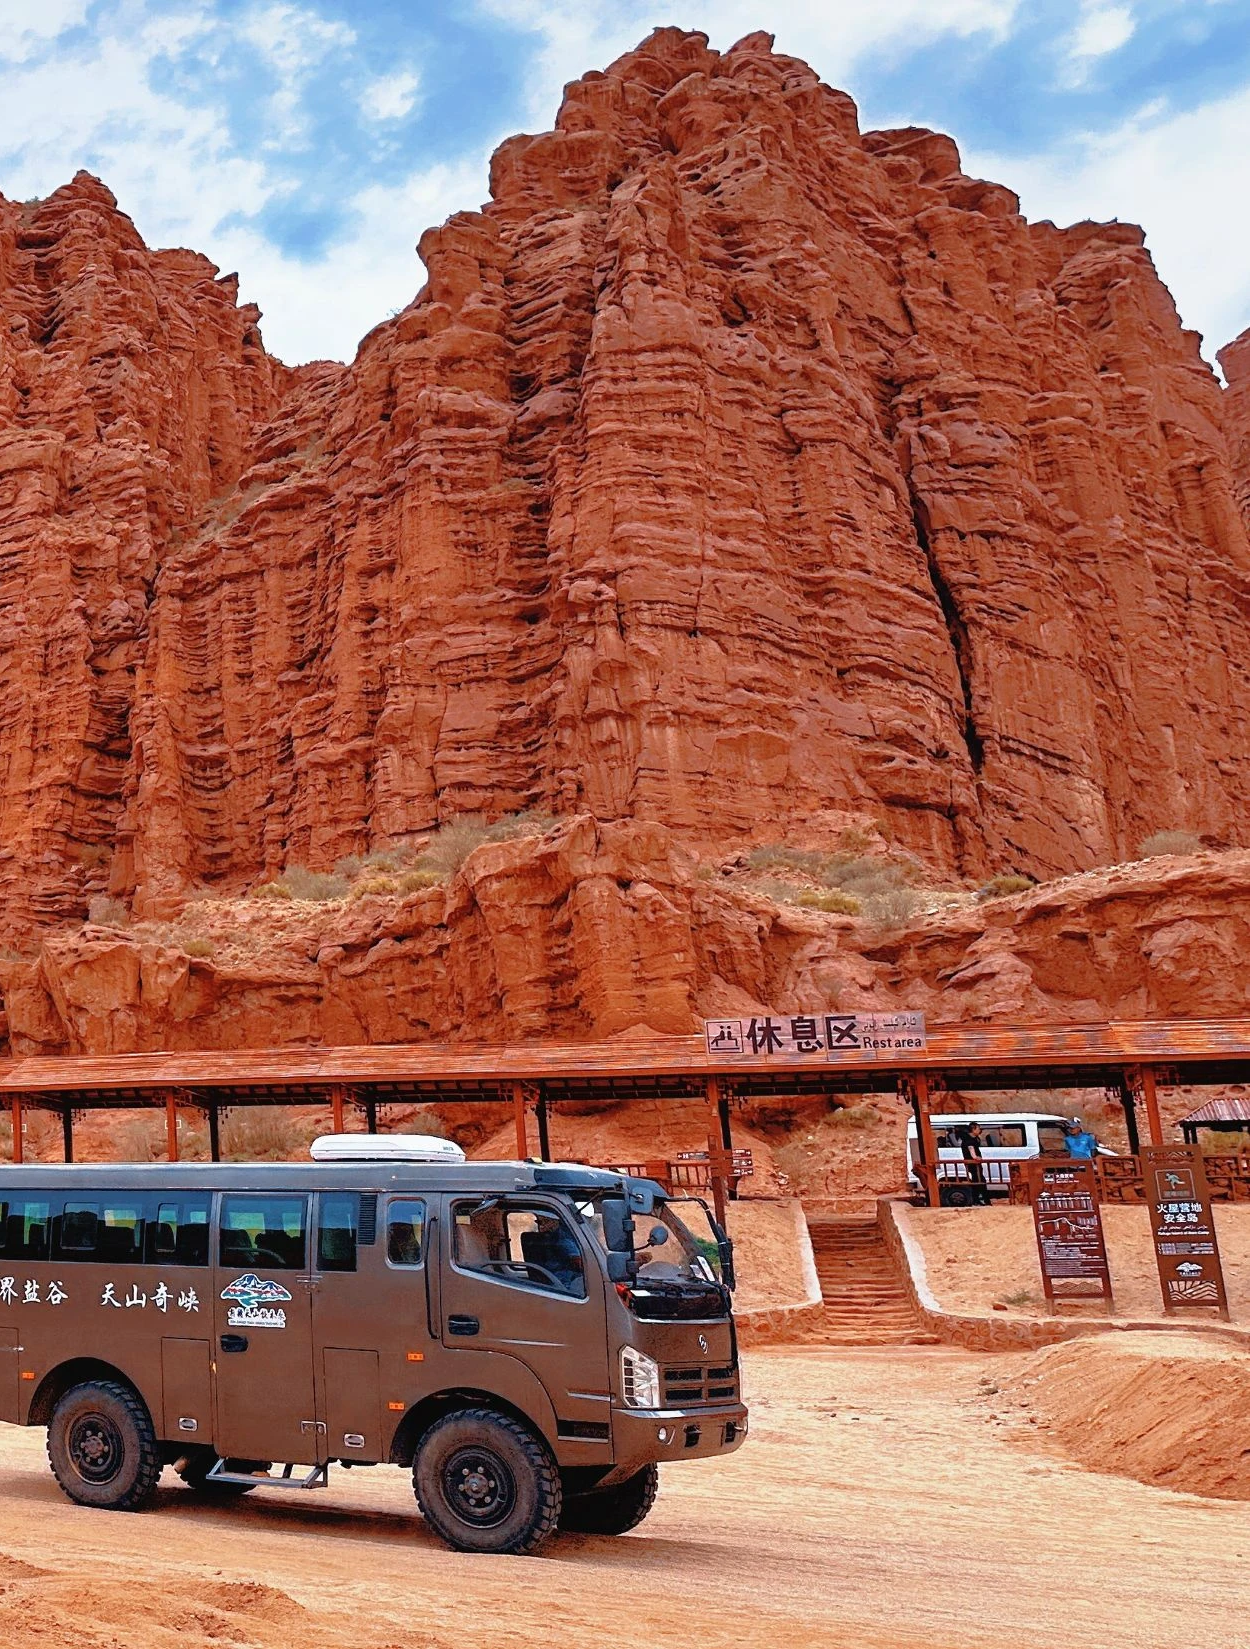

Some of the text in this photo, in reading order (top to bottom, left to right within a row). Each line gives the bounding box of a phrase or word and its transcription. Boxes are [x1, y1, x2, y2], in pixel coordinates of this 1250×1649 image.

[746, 1015, 861, 1055] 休息区
[862, 1036, 922, 1049] Rest area
[1156, 1202, 1203, 1214] 火星营地
[1163, 1213, 1199, 1224] 安全岛
[100, 1281, 200, 1313] 天山奇峡
